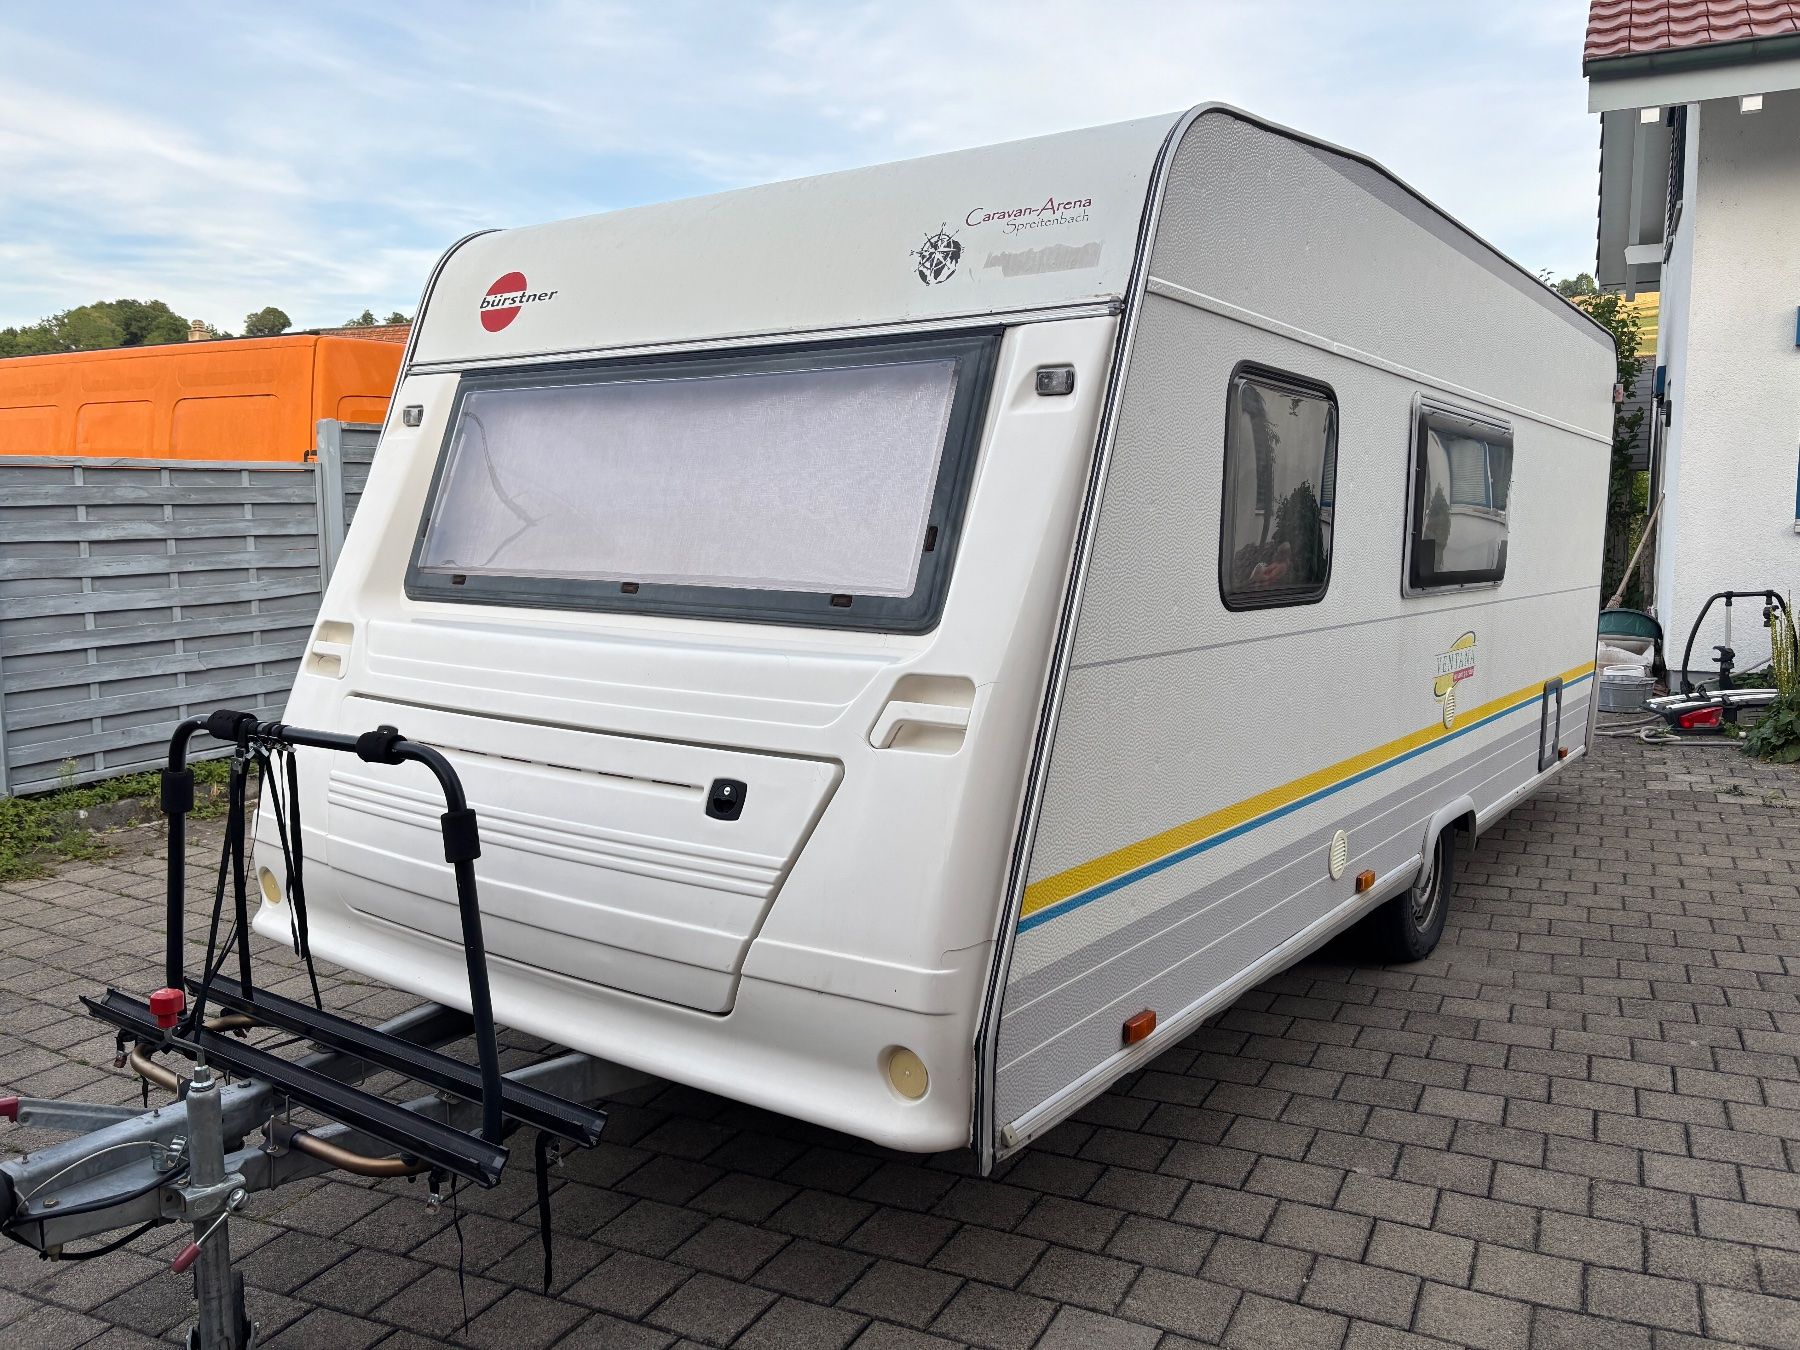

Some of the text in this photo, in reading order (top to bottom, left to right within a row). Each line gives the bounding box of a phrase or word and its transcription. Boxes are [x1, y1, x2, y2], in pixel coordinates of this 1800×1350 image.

[965, 197, 1092, 227] Caravan-Arena
[1002, 209, 1089, 237] Spreitenbach
[479, 290, 559, 309] bürstner
[1436, 648, 1475, 675] VENTANA
